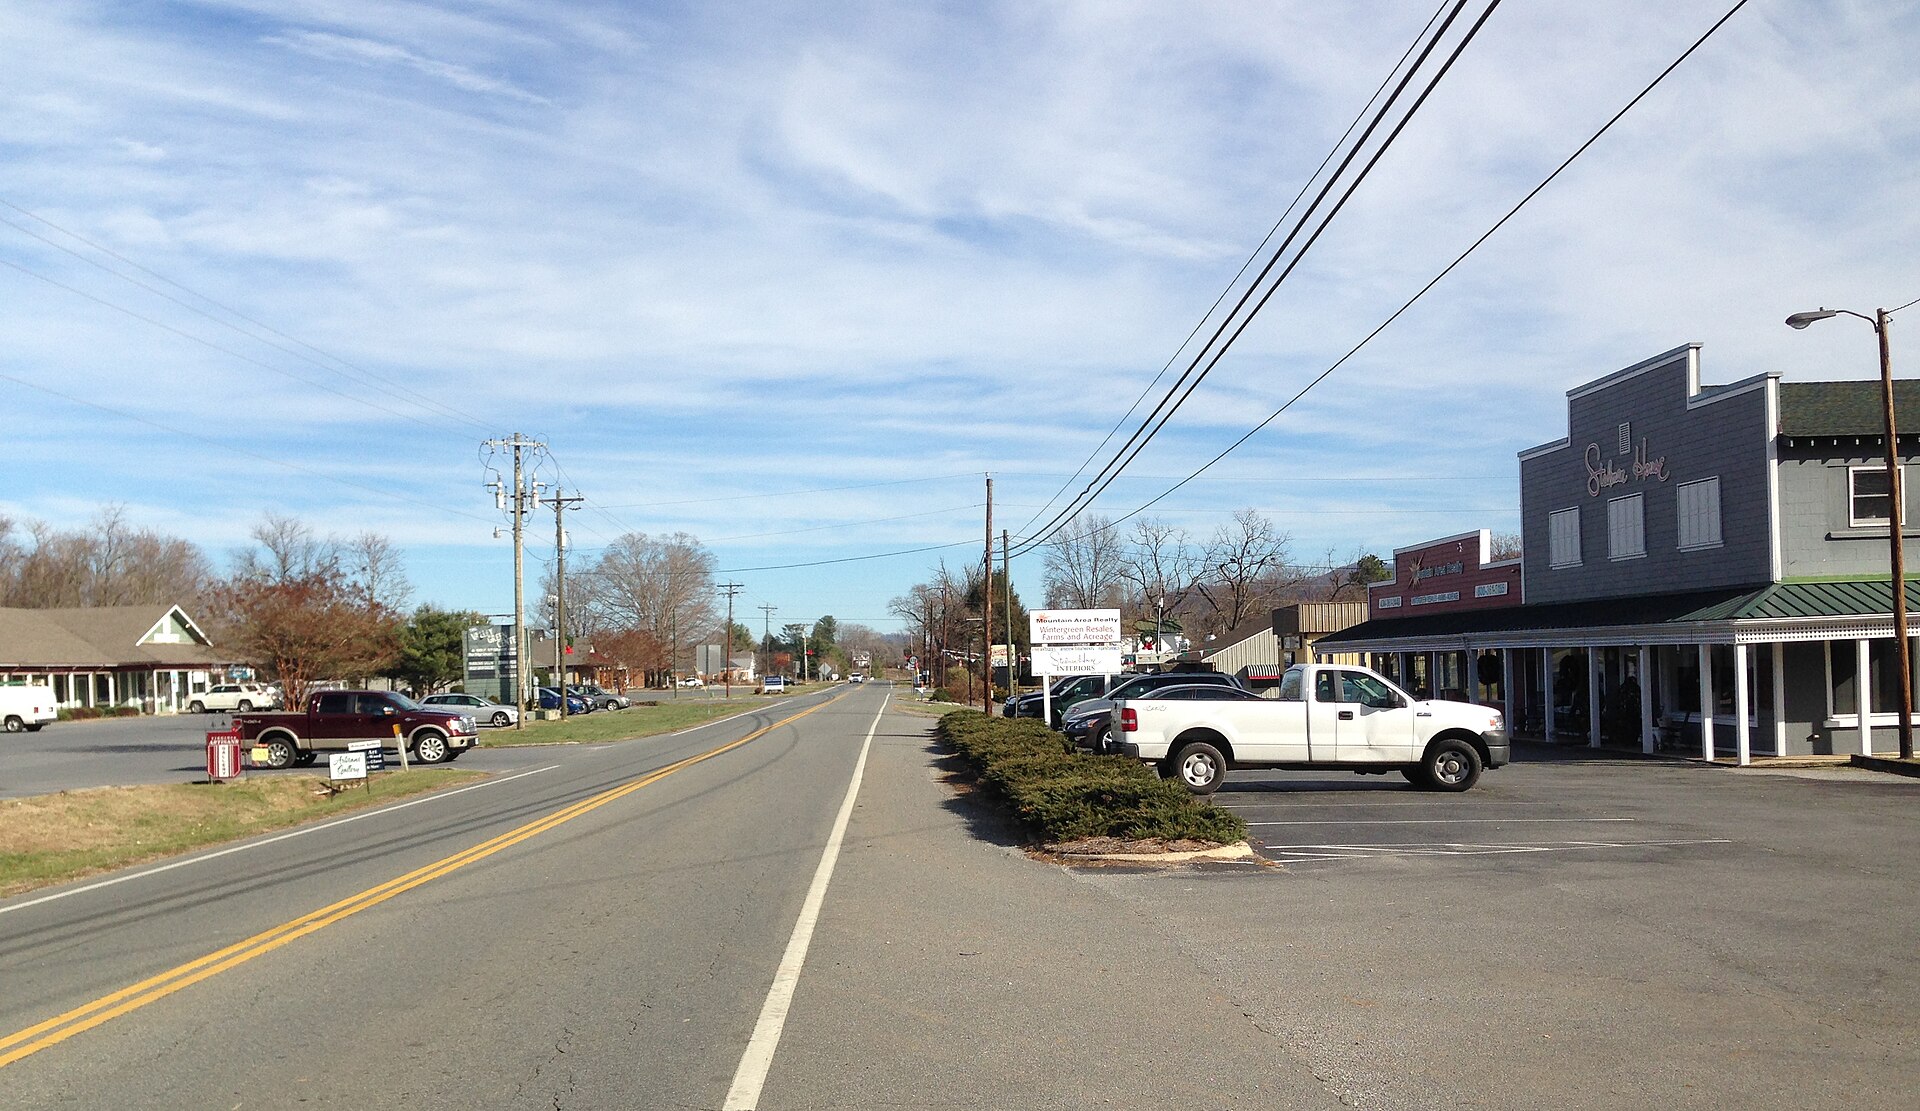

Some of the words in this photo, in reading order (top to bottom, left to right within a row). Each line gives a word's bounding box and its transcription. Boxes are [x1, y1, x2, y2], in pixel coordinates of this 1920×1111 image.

[1039, 626, 1084, 634] Wintergreen
[1042, 633, 1065, 641] Farms
[1083, 633, 1113, 641] Acreage
